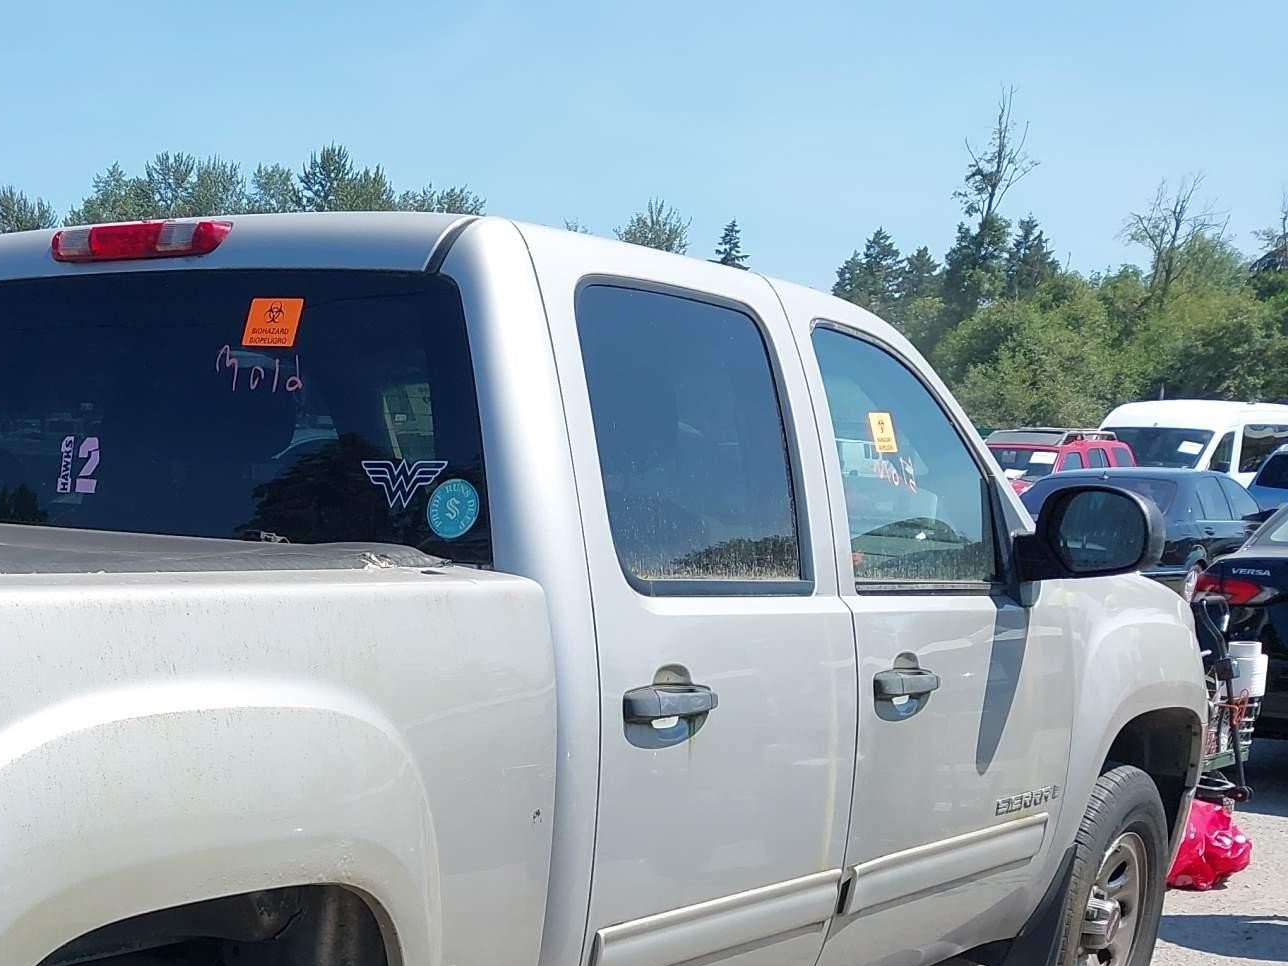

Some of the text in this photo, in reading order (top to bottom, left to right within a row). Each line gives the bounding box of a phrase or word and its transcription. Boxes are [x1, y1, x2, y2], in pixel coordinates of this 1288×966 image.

[251, 327, 289, 335] BIOHAZARD
[248, 337, 288, 345] BIOPELIGRO
[59, 439, 73, 491] HAWKS
[1232, 567, 1271, 577] VERSA
